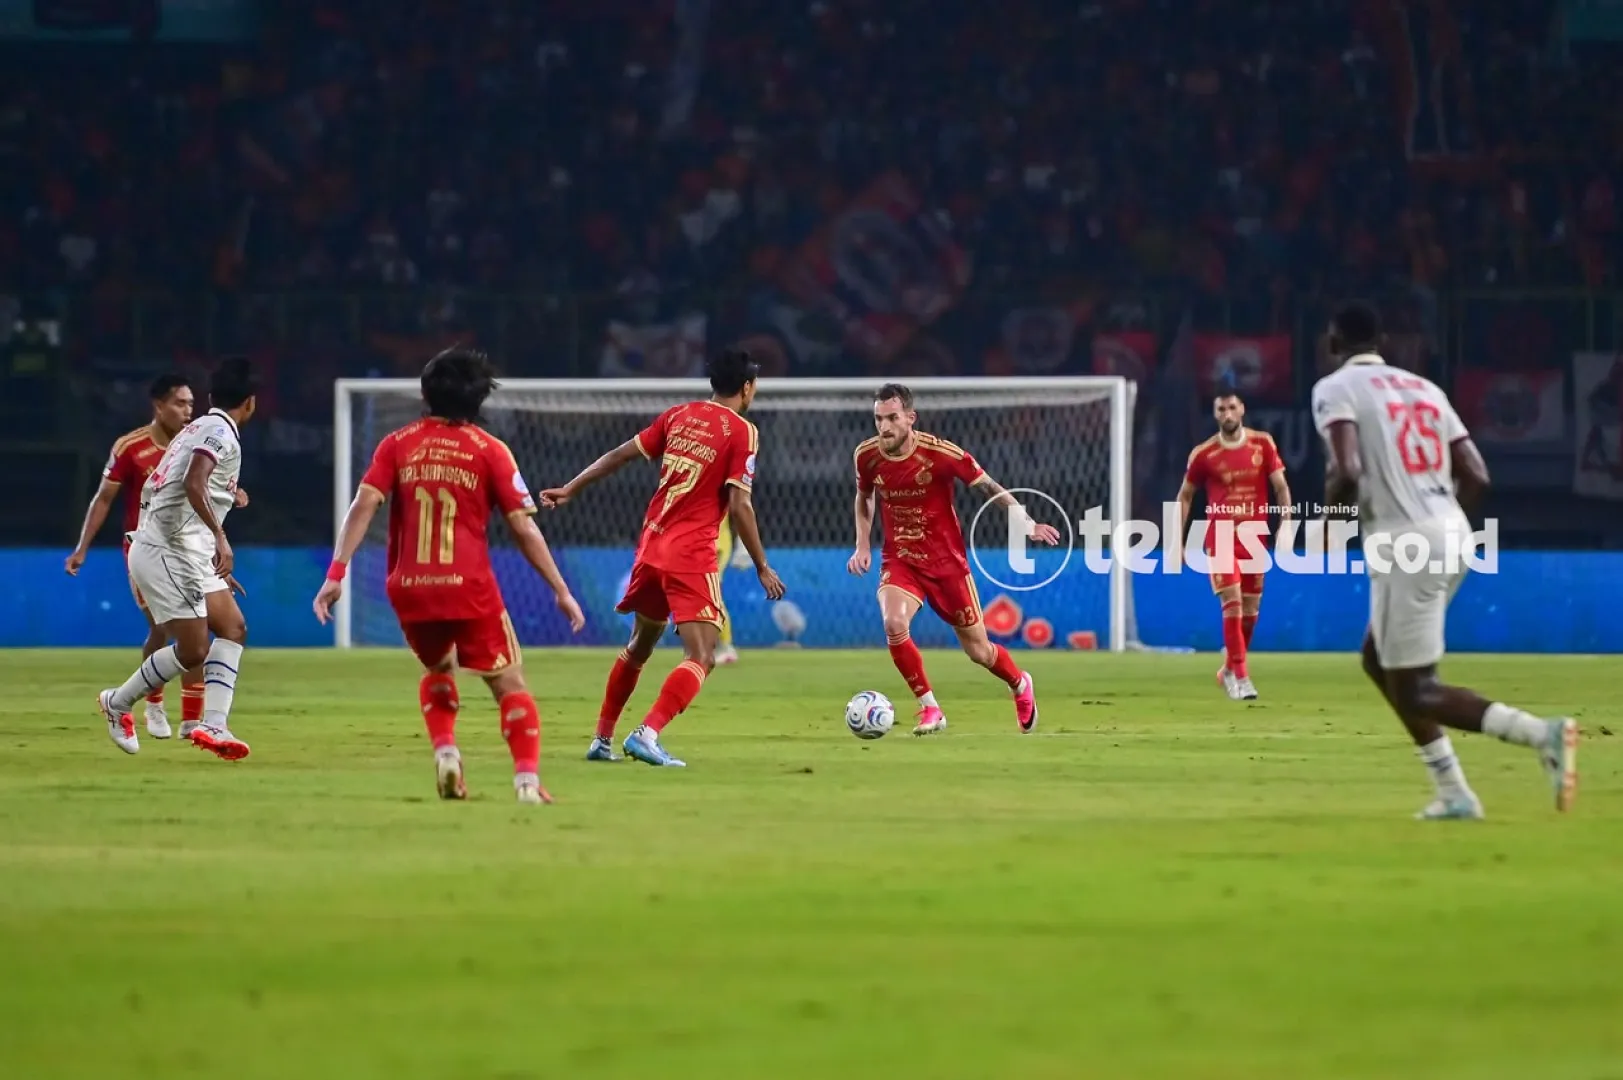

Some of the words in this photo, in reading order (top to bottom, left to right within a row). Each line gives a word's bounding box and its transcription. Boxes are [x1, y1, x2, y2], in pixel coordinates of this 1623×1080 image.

[1386, 400, 1443, 475] 25
[659, 452, 703, 517] 77
[889, 488, 926, 498] MACAN
[415, 486, 457, 564] 11
[401, 573, 413, 587] Le
